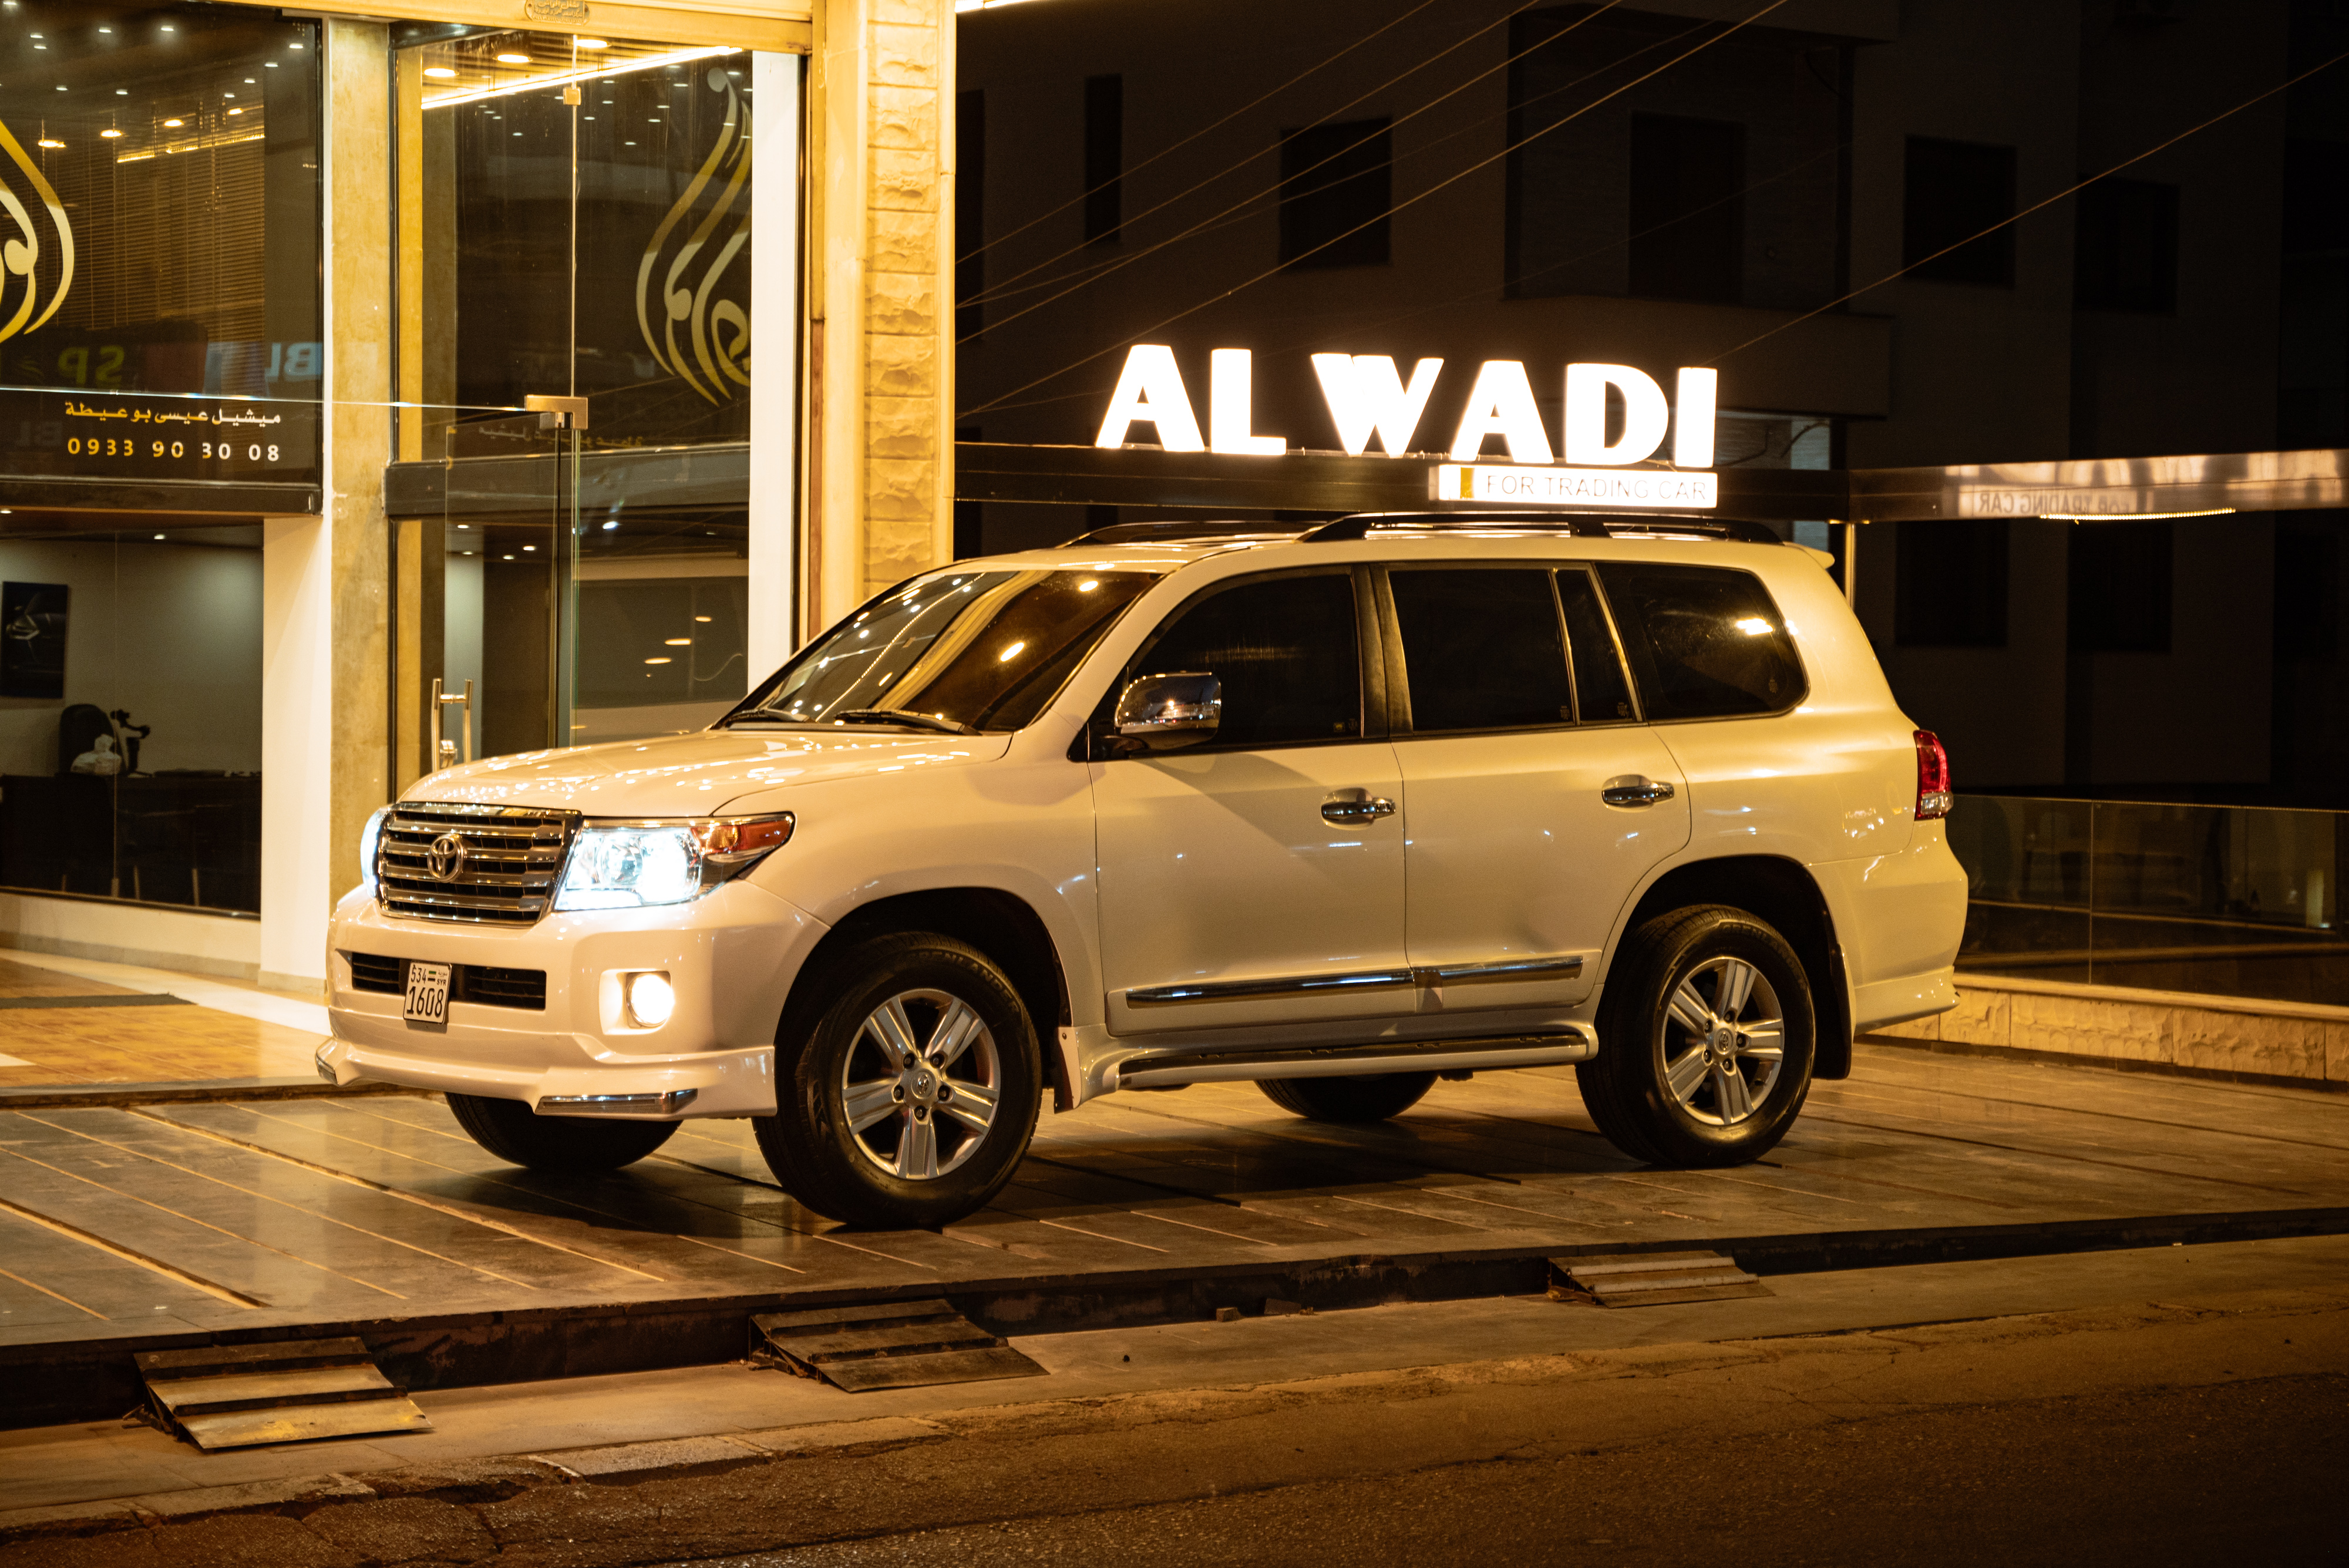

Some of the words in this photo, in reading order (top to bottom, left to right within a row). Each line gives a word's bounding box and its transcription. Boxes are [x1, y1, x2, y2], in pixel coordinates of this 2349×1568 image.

[65, 401, 128, 422] عيطة
[130, 408, 152, 423] بو
[1096, 344, 1286, 455] AL
[1311, 352, 1717, 468] WADI
[154, 409, 209, 425] عيسى
[211, 408, 281, 428] ميشيل
[68, 438, 133, 456] 0933
[152, 440, 184, 458] 90
[202, 442, 231, 460] 30
[248, 443, 280, 462] 08
[1487, 475, 1534, 495] FOR
[1544, 476, 1648, 499] TRADING
[1658, 480, 1706, 500] CAR
[410, 967, 426, 984] 534
[407, 987, 444, 1018] 1608
